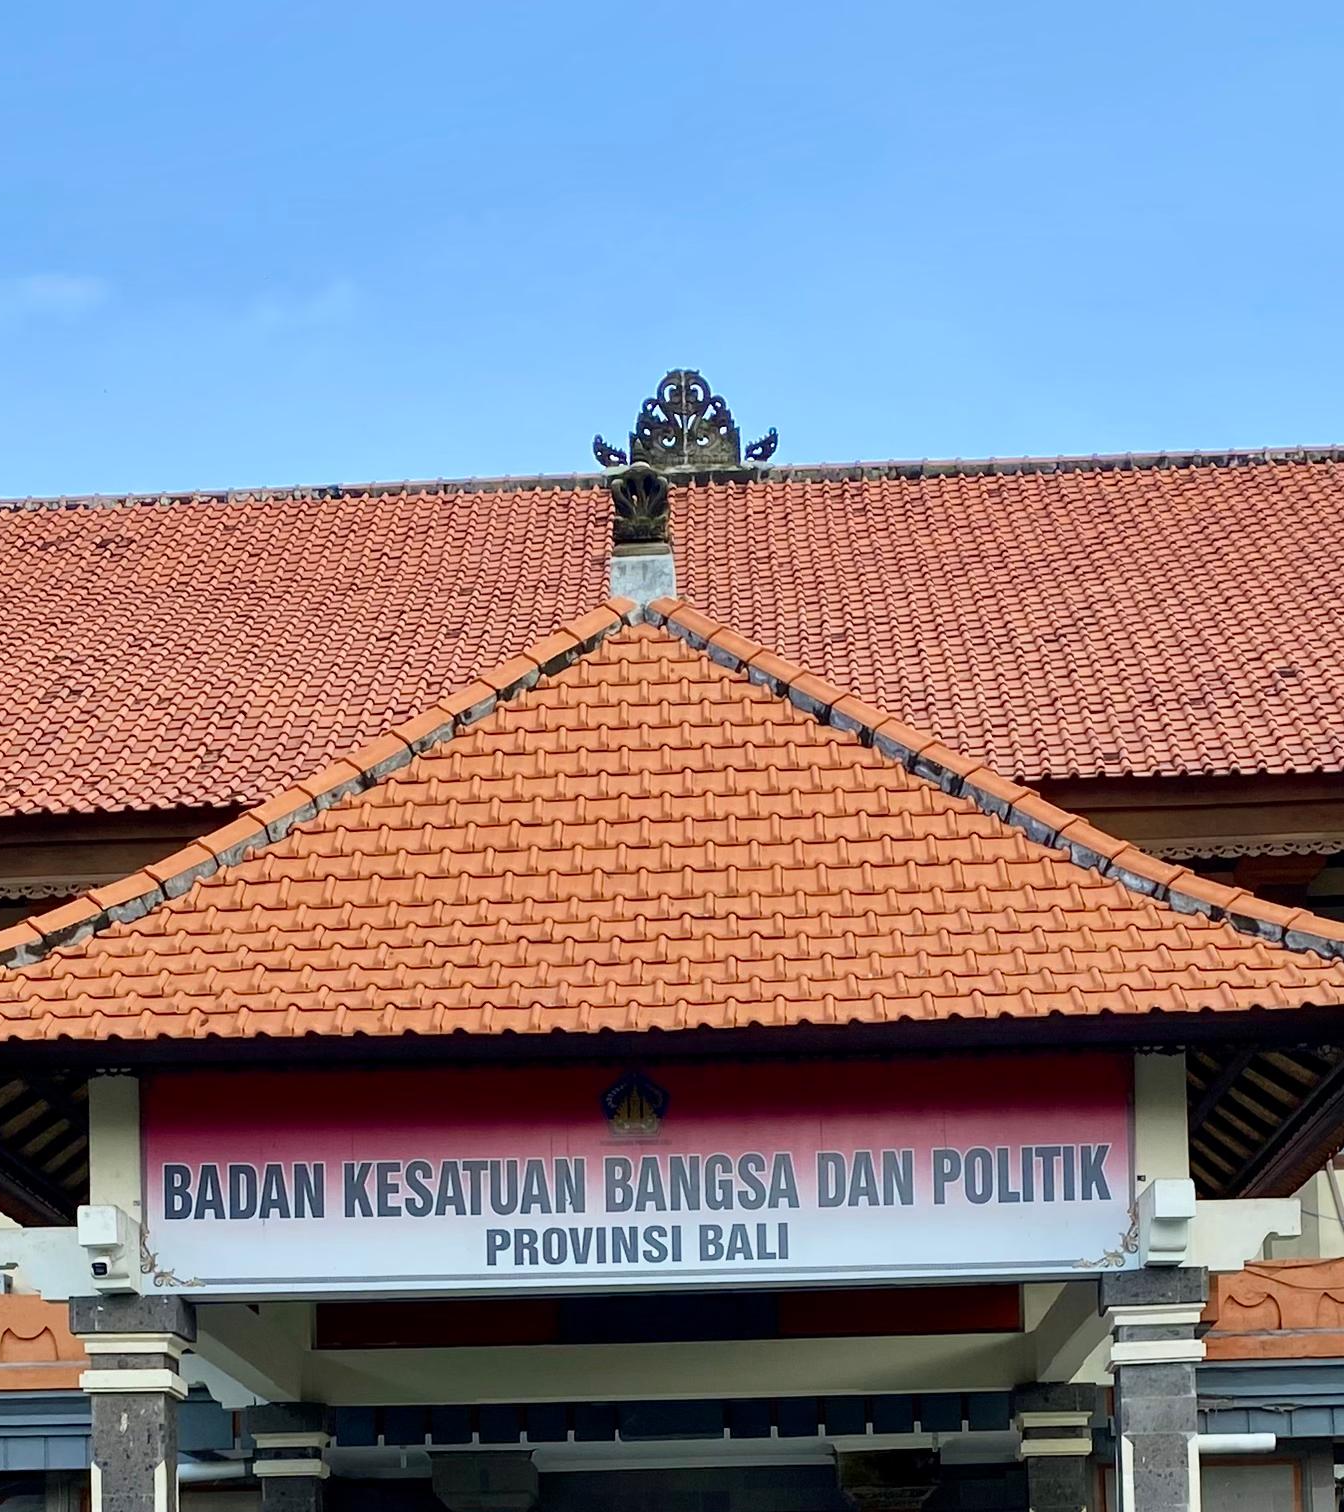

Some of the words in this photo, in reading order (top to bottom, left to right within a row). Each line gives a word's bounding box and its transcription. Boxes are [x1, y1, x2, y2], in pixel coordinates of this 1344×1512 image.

[163, 1163, 325, 1220] BADAN
[344, 1157, 586, 1218] KESATUAN
[605, 1152, 801, 1213] BANGSA
[817, 1149, 915, 1208] DAN
[933, 1144, 1112, 1205] POLITIK
[486, 1225, 683, 1267] PROVINSI
[699, 1222, 789, 1262] BALI
